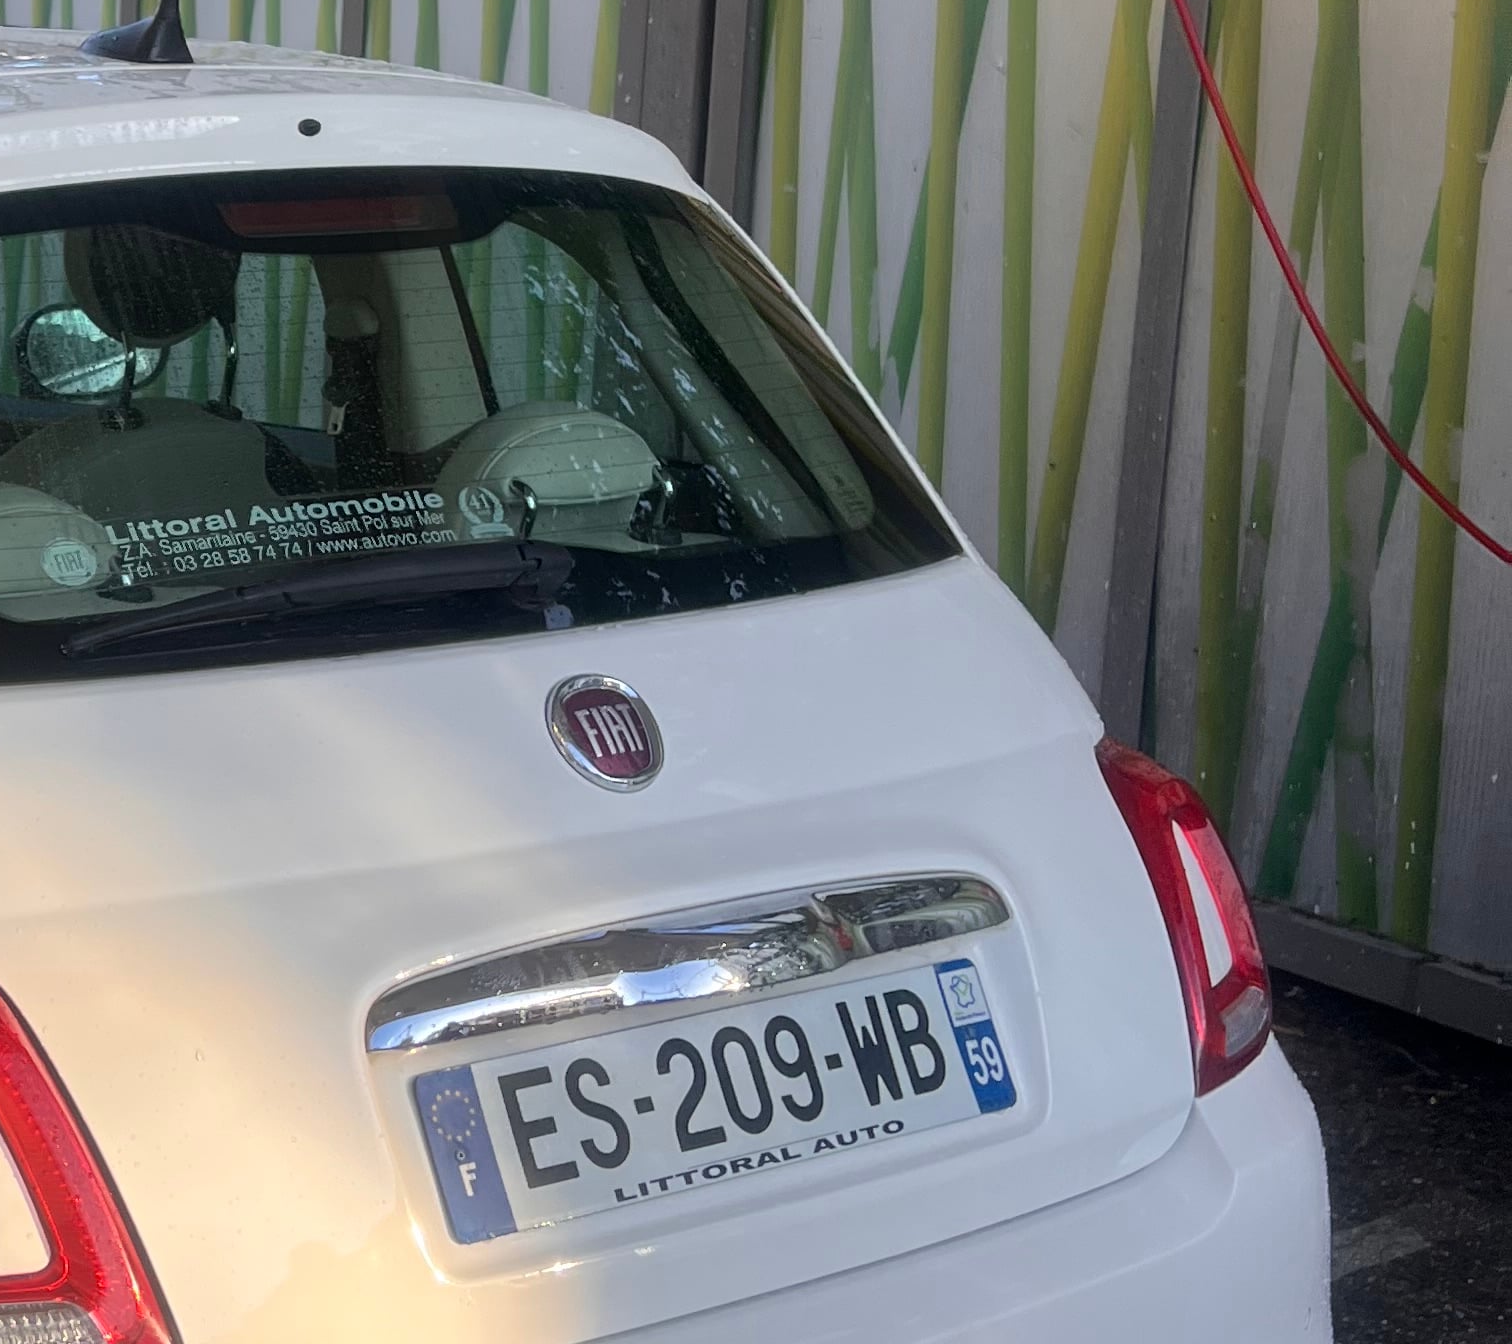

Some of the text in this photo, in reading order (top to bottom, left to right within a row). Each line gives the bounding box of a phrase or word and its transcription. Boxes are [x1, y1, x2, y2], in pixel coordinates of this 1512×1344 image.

[104, 490, 445, 545] Littoral Automobile
[268, 522, 318, 541] 59430
[320, 516, 364, 535] Saint
[362, 514, 388, 532] Pol
[391, 516, 415, 529] sur
[416, 510, 445, 526] Mer
[53, 550, 85, 573] FIAT
[173, 555, 198, 572] 03
[200, 551, 225, 568] 28
[227, 547, 252, 565] 58
[252, 544, 277, 561] 74
[279, 542, 303, 559] 74
[316, 529, 457, 554] www.autovo.com
[574, 702, 644, 758] FIAT
[459, 988, 1004, 1197] F ES-209-WB 59
[613, 1119, 906, 1203] LITTORAL AUTO
